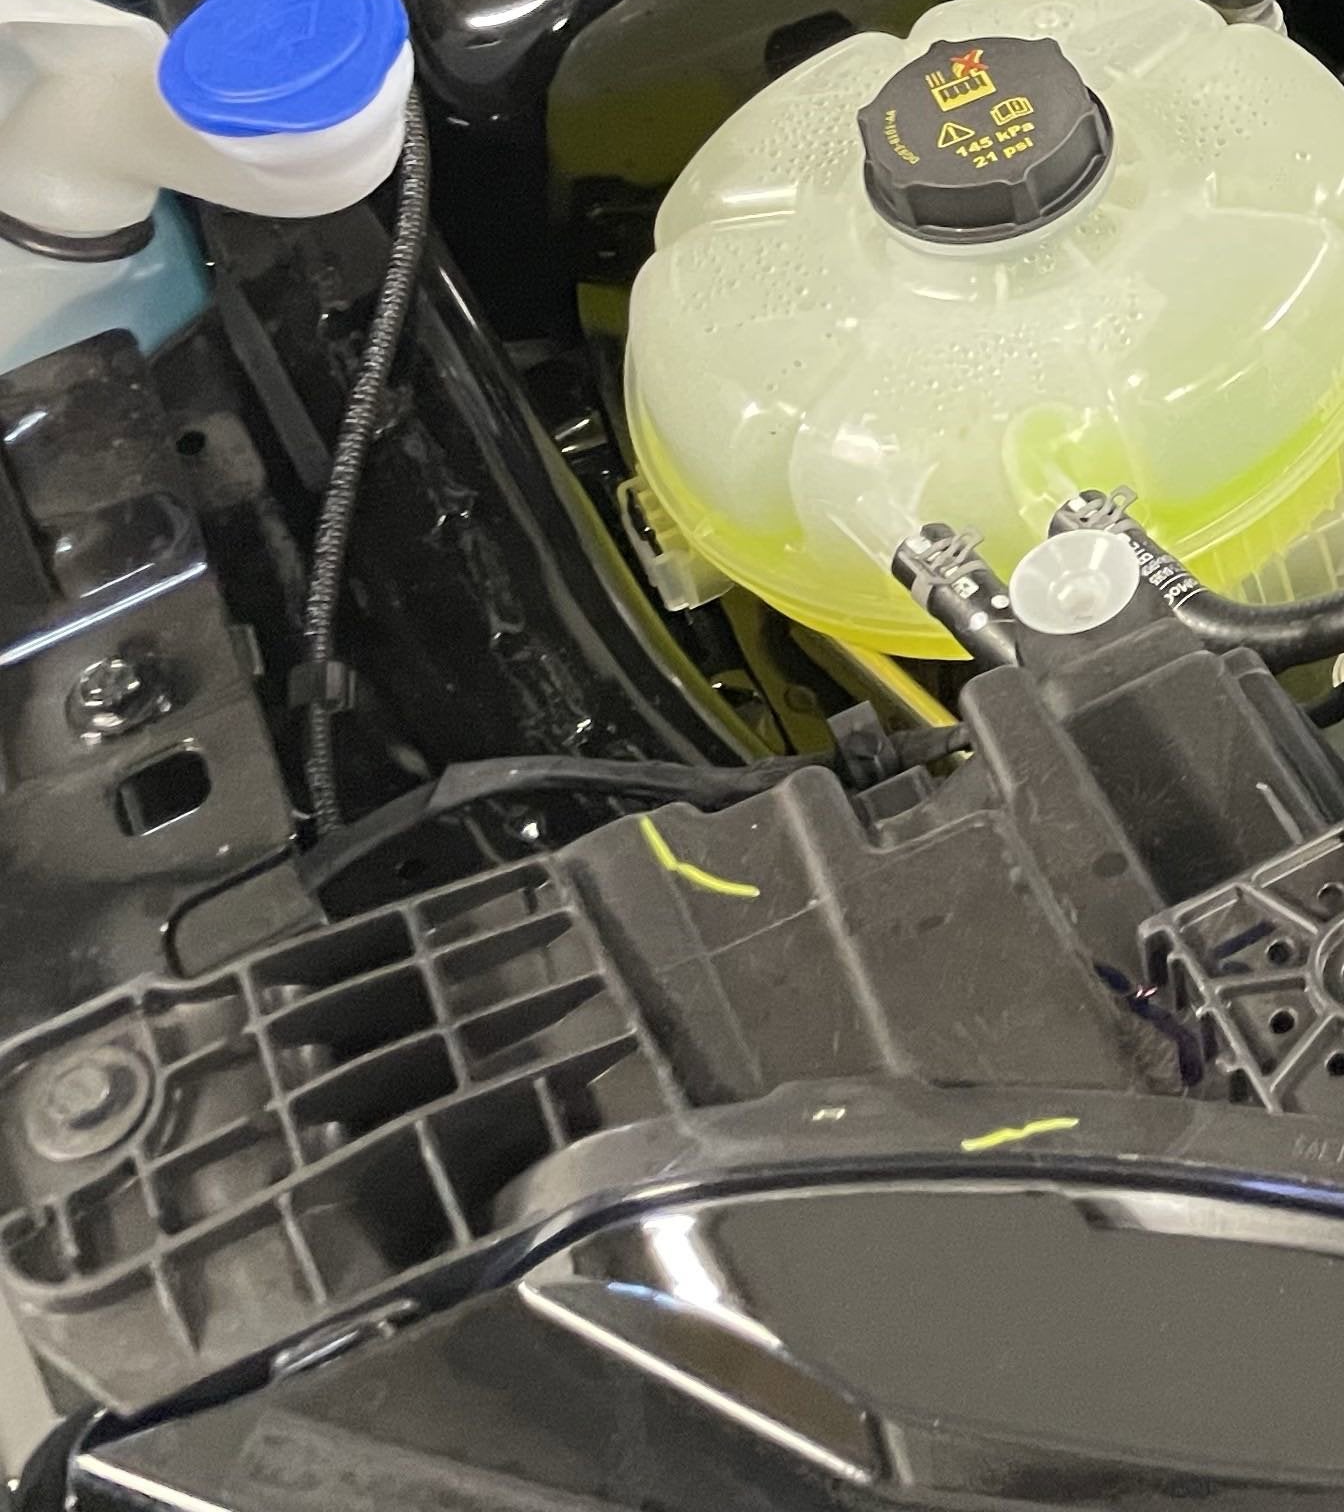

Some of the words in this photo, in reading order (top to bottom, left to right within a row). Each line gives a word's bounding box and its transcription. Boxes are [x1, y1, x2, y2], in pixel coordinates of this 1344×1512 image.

[956, 137, 993, 156] 145
[996, 123, 1034, 142] kPa
[973, 152, 998, 168] 21
[1003, 138, 1033, 158] psi
